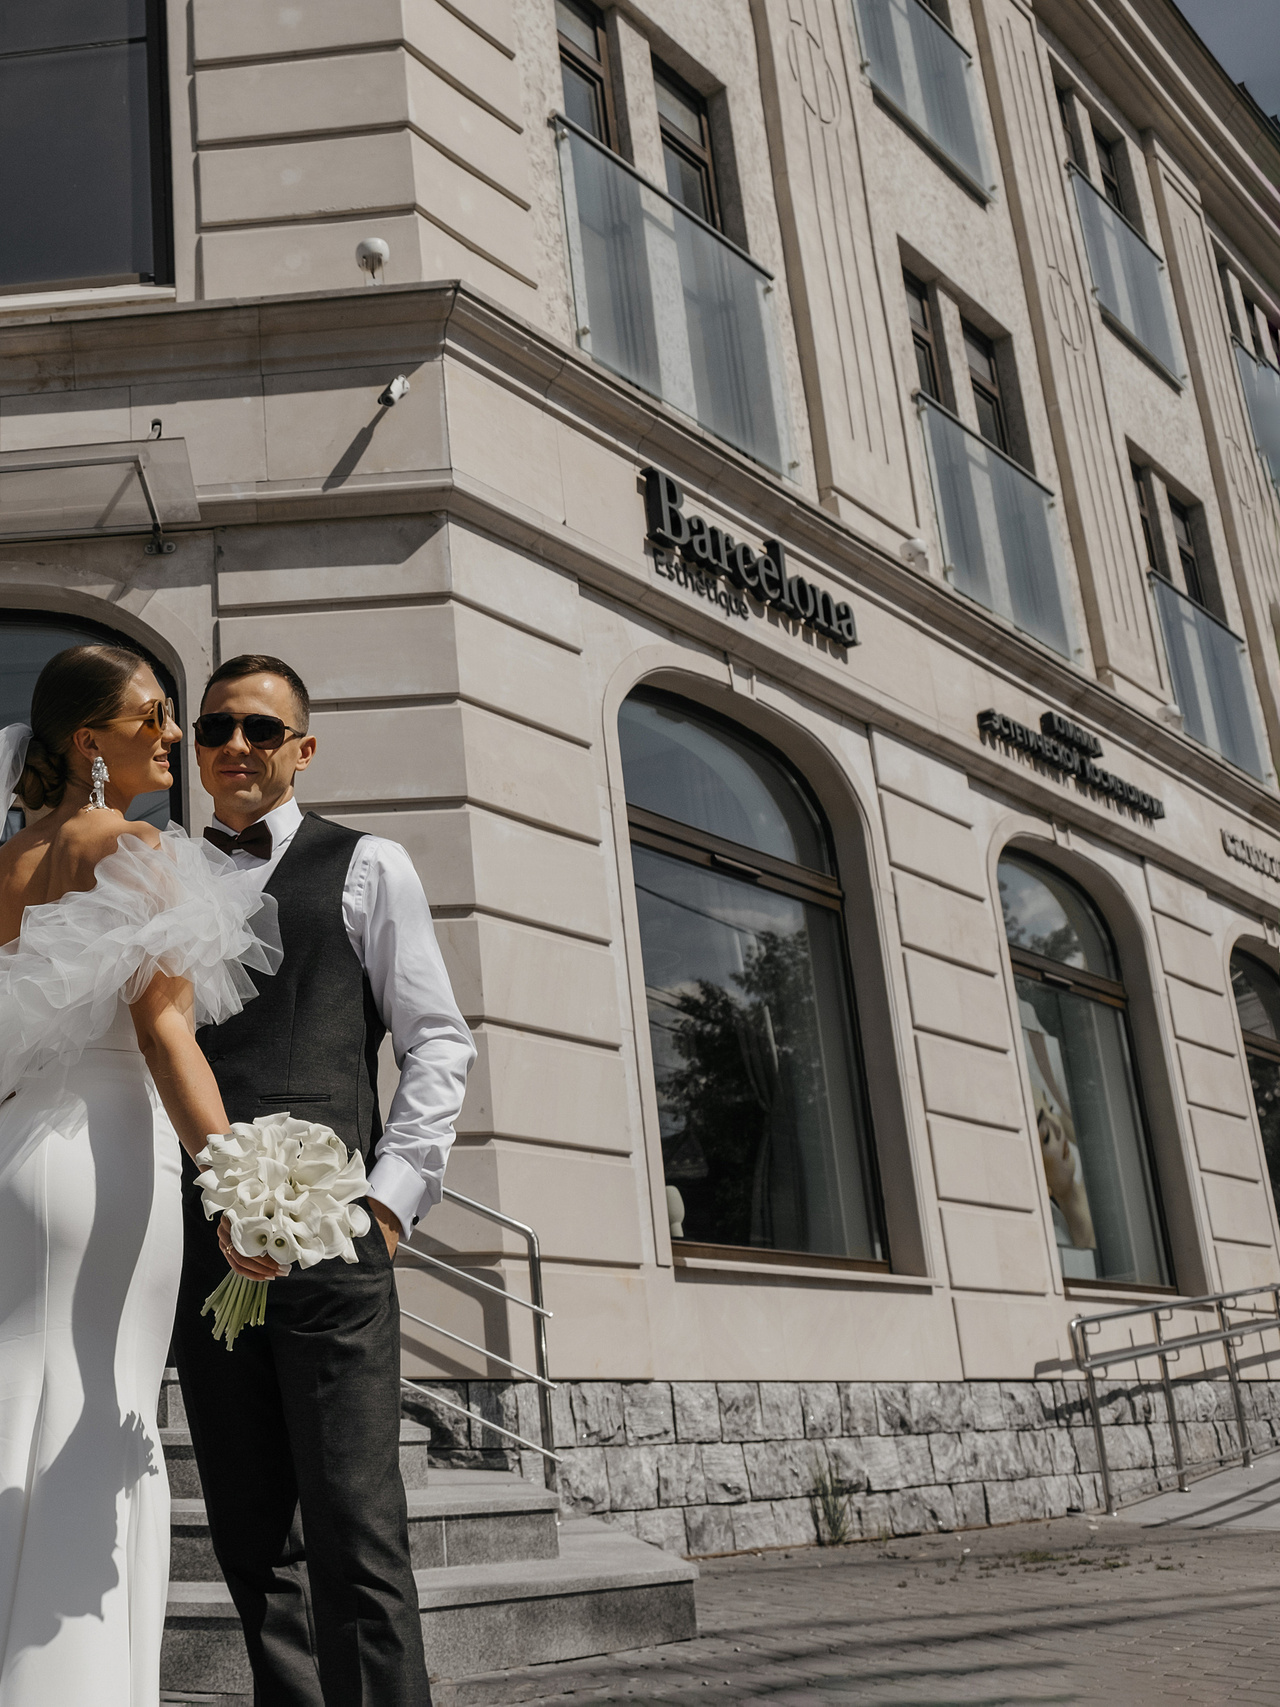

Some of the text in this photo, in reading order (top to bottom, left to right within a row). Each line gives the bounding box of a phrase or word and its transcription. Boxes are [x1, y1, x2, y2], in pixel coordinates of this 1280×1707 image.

[640, 466, 862, 648] Barcelona
[976, 708, 1083, 778] ЭСТЕТИЧЕСКОЙ
[1041, 711, 1103, 758] КЛИНИКА
